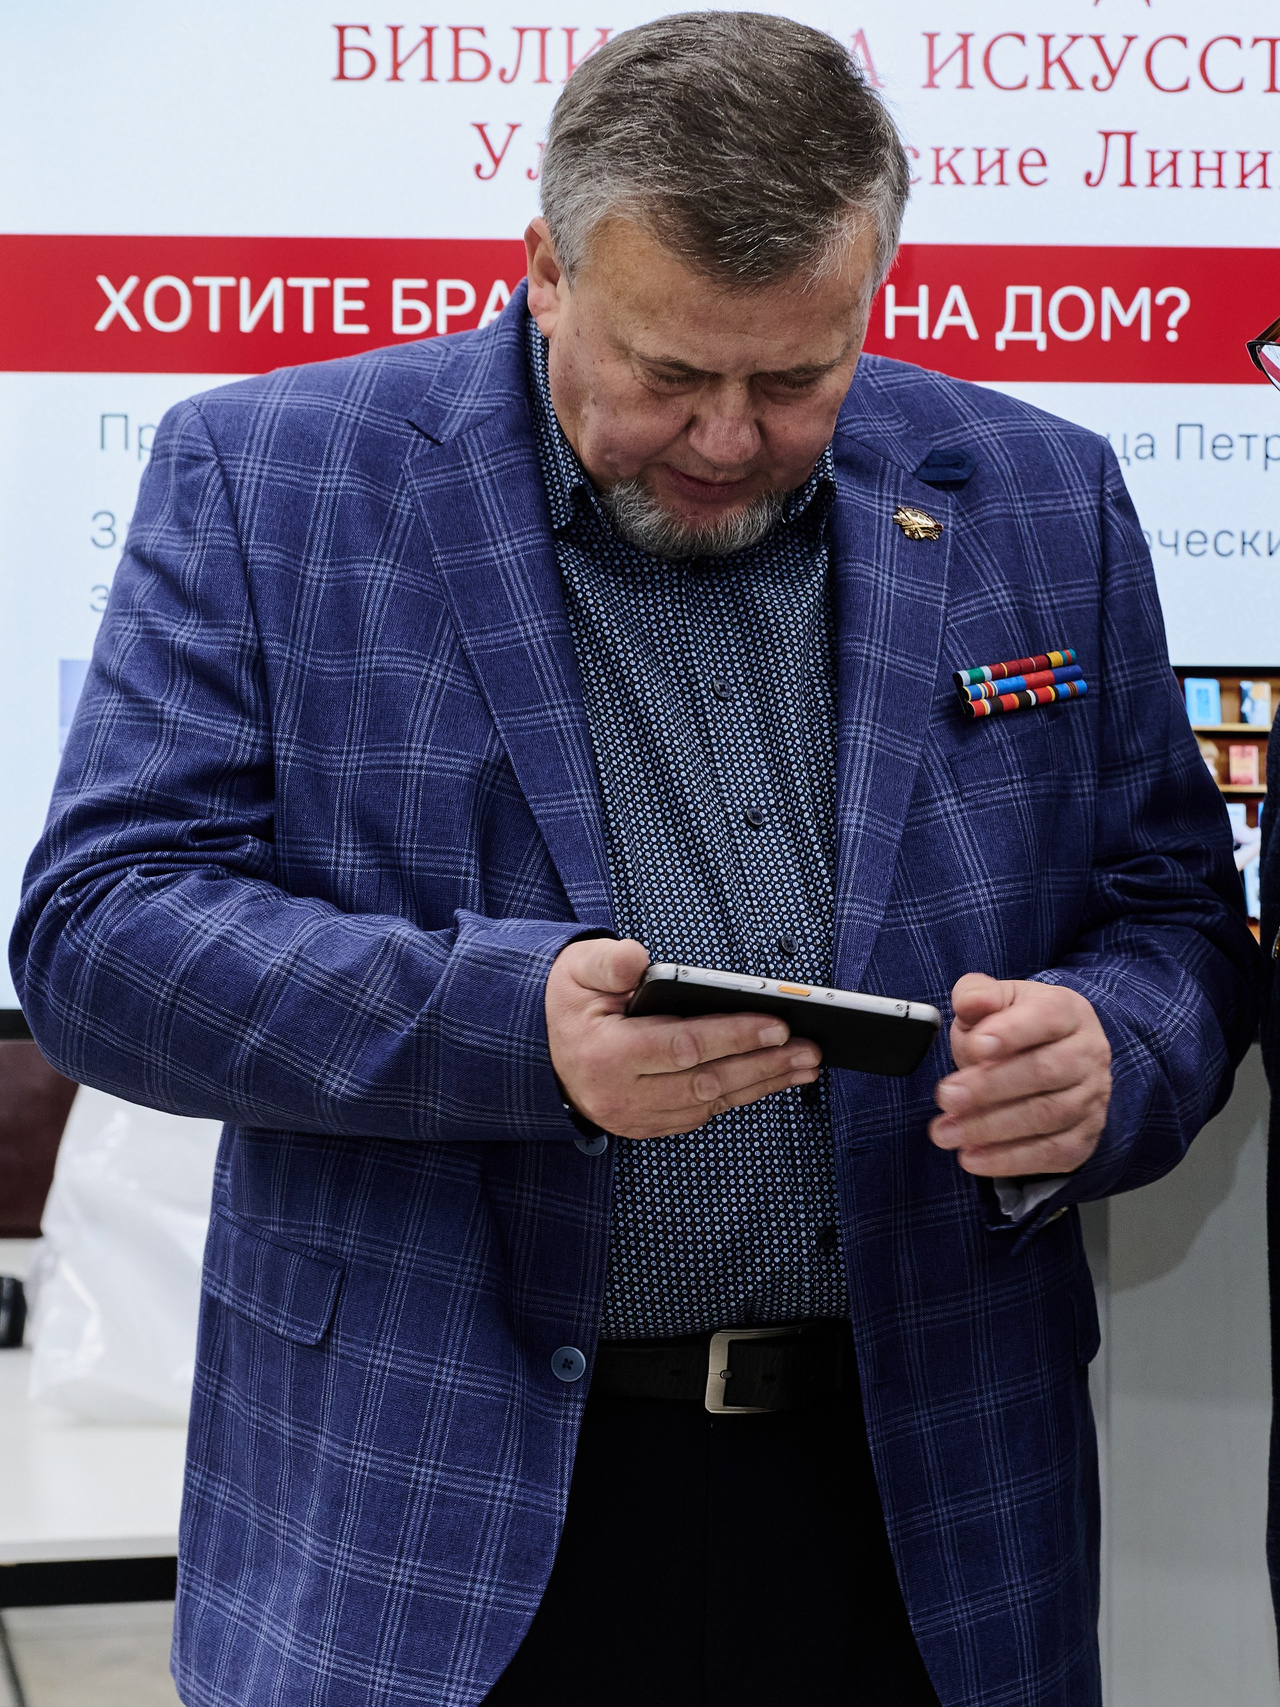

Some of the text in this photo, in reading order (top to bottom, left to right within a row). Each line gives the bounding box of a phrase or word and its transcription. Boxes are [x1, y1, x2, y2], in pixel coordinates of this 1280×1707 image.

[94, 275, 1192, 352] ХОТИТЕ БРА НА ДОМ?
[100, 412, 157, 462] Пр
